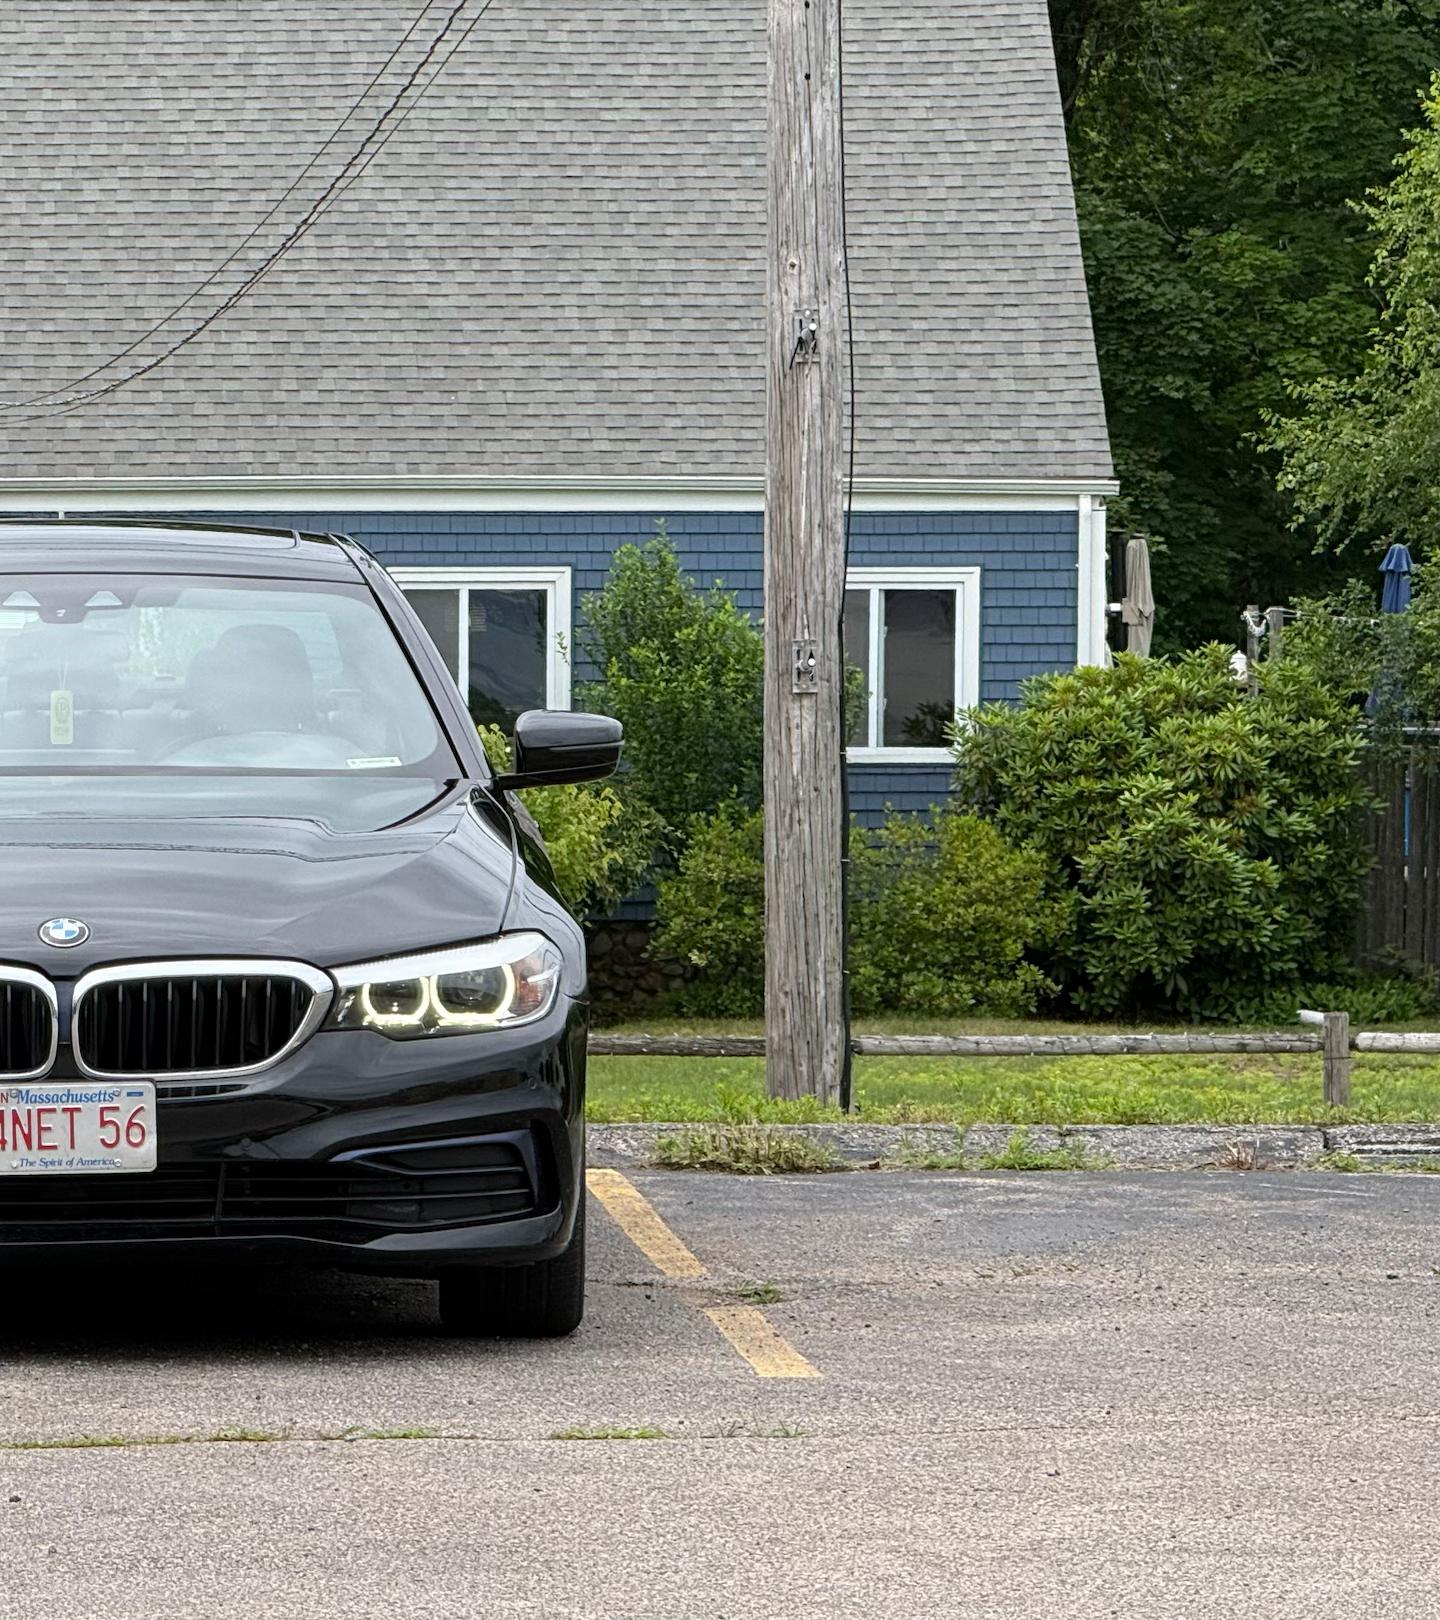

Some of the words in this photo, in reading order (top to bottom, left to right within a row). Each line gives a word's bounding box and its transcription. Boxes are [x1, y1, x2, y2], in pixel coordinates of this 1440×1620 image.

[17, 1088, 115, 1105] Massachusetts
[99, 1104, 146, 1149] 56
[20, 1158, 37, 1167] The
[38, 1157, 62, 1169] Spirit
[66, 1157, 74, 1168] of
[76, 1156, 115, 1166] America
